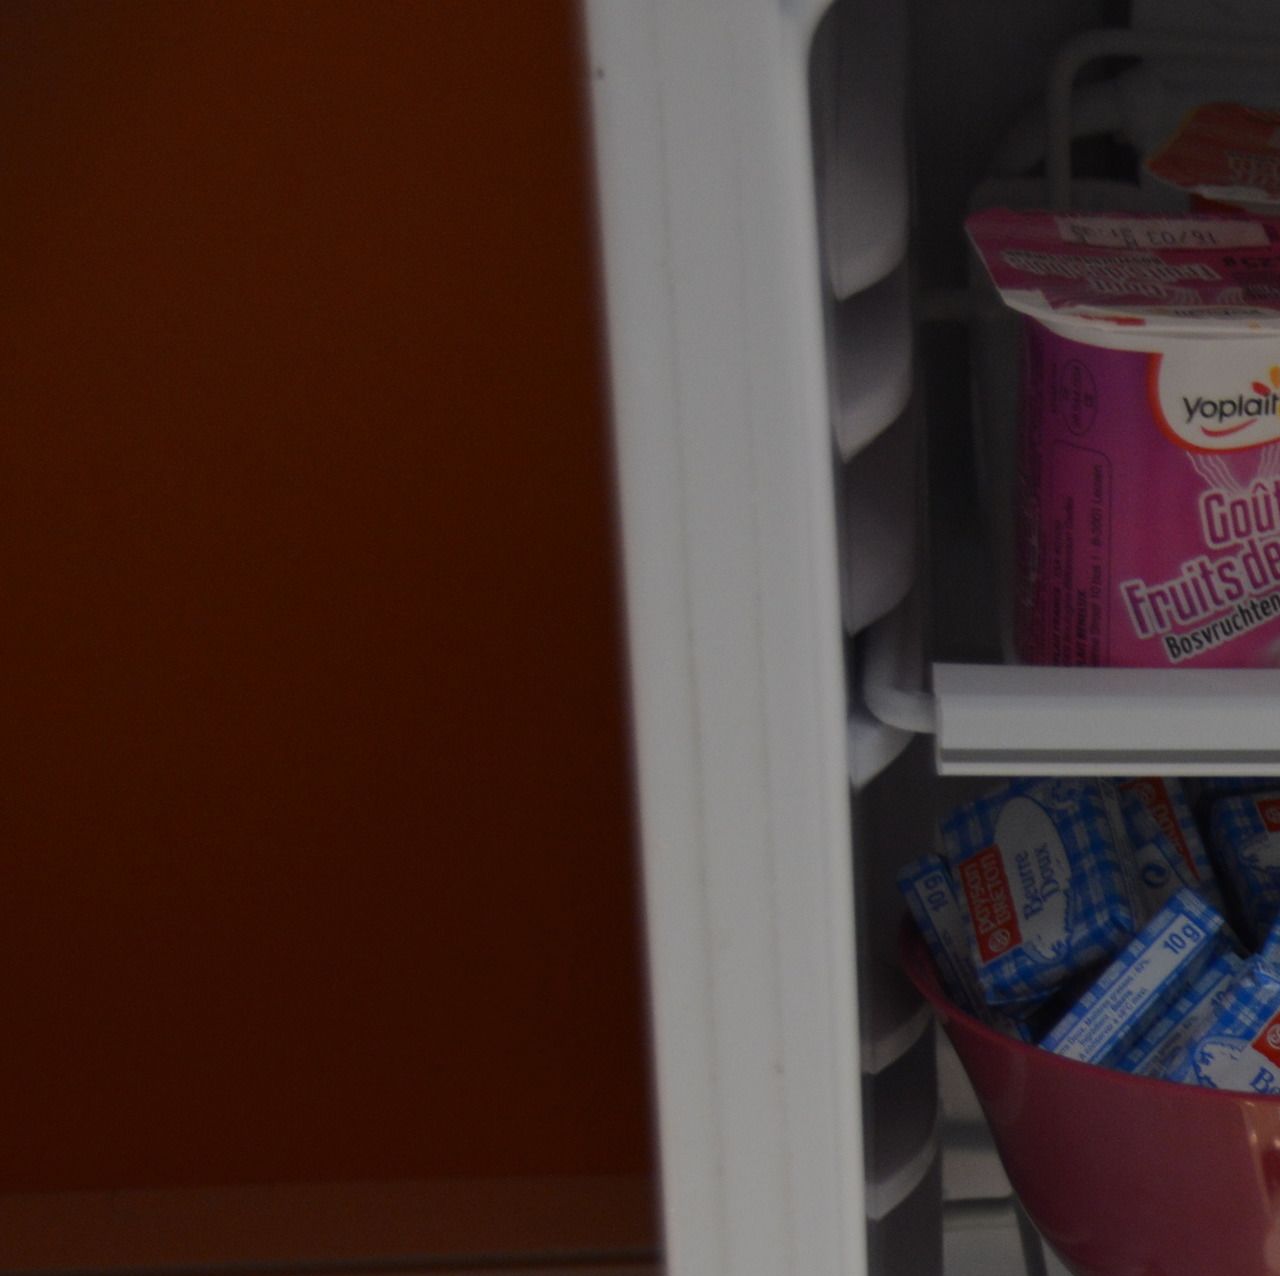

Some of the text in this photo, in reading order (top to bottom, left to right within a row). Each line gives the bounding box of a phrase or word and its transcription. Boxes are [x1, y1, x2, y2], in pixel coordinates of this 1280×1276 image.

[1183, 392, 1280, 422] Yoplait
[1126, 561, 1245, 635] Fruits
[1015, 850, 1044, 921] Beurre
[1033, 842, 1060, 904] Doux
